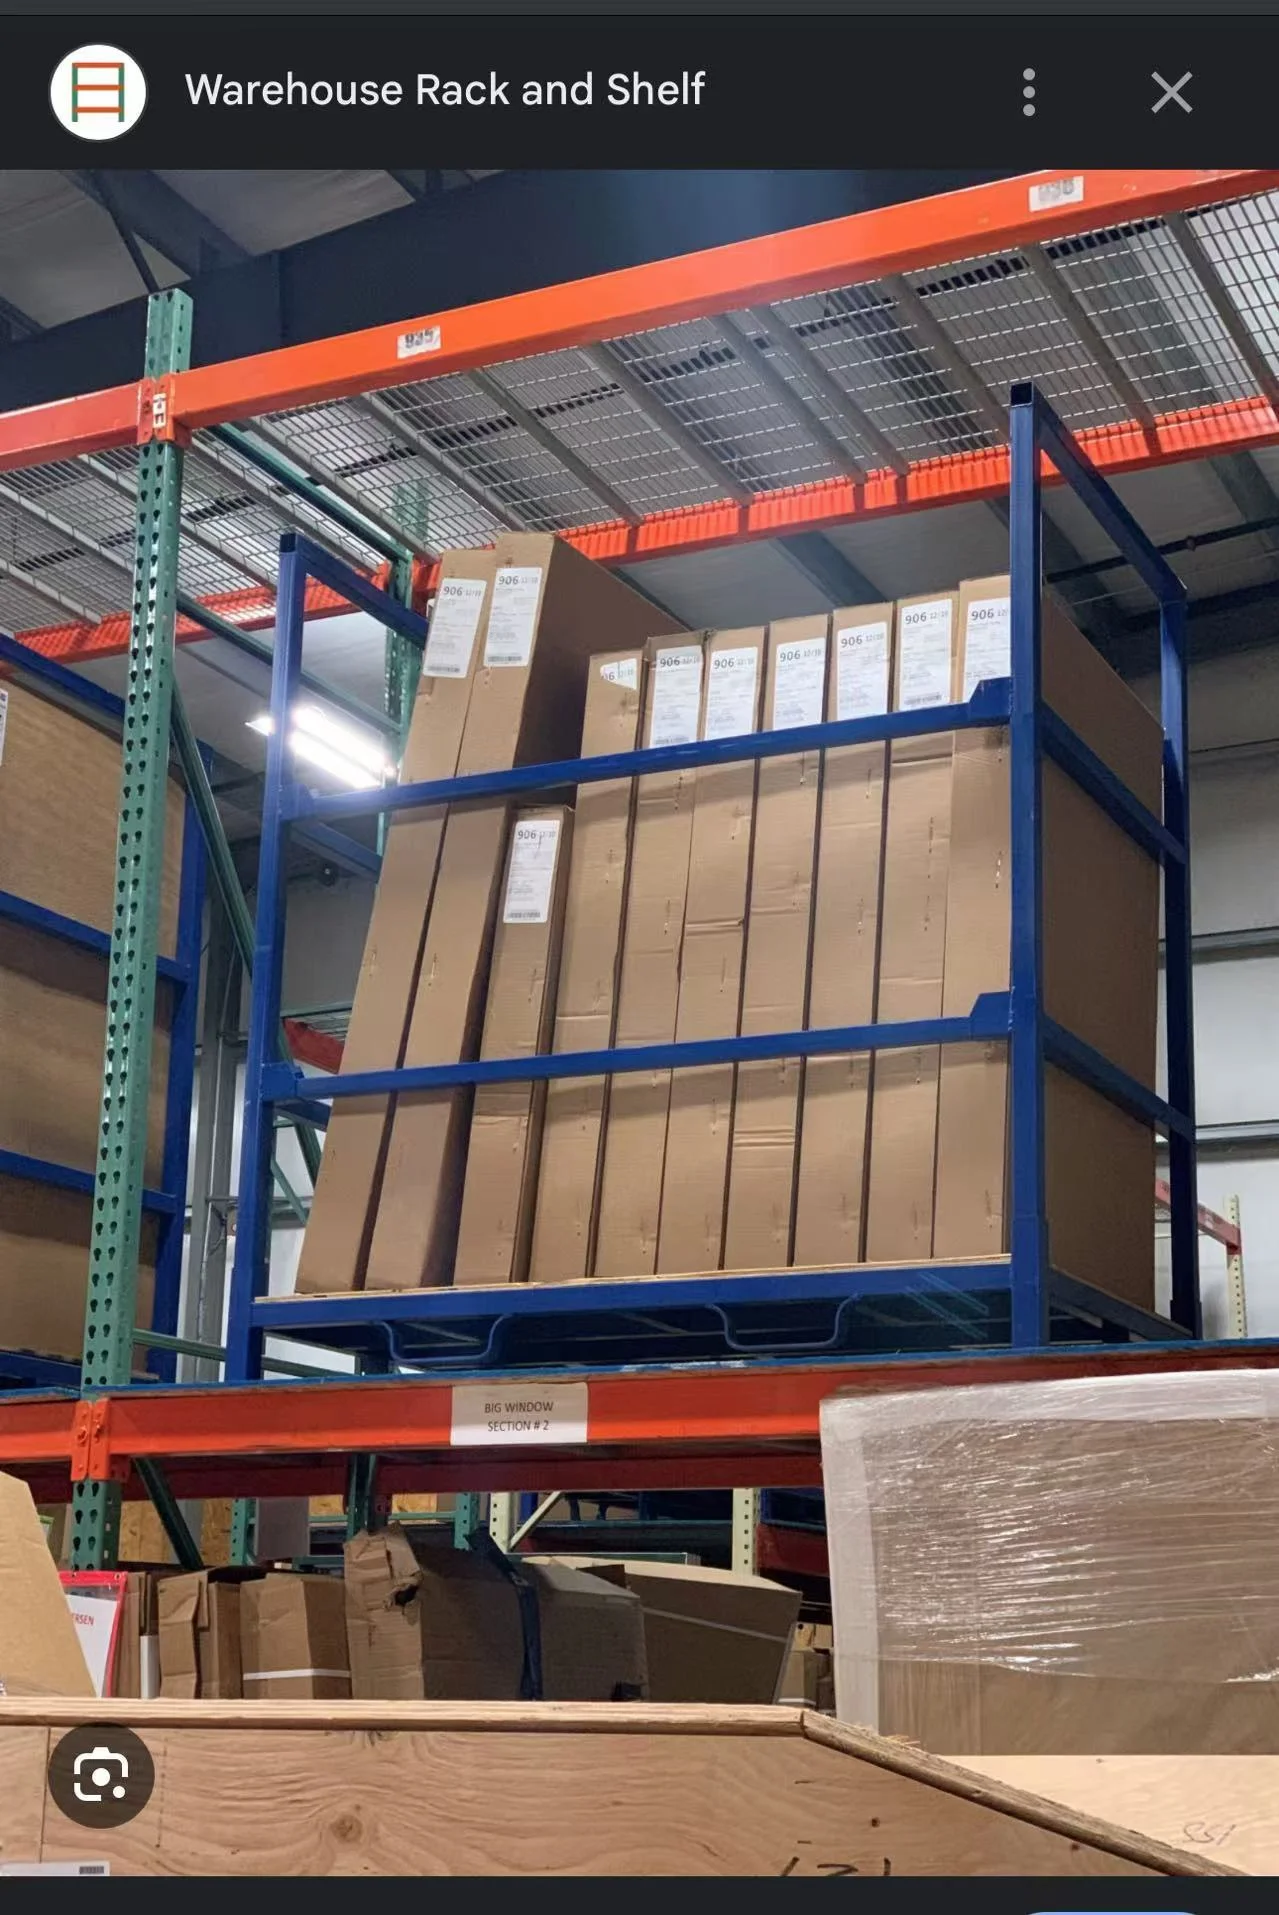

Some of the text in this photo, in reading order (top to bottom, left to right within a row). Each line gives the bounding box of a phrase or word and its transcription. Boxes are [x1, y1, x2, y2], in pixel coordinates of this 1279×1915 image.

[499, 575, 519, 585] 906
[443, 585, 463, 596] 906
[905, 611, 927, 625] 906
[971, 608, 995, 621] 906
[841, 635, 863, 649] 906
[660, 656, 681, 668] 906
[780, 650, 801, 663] 906
[714, 658, 735, 670] 906
[518, 829, 537, 840] 906
[484, 1401, 554, 1413] BIG WINDOW
[487, 1420, 531, 1432] SECTION
[543, 1420, 549, 1431] 2
